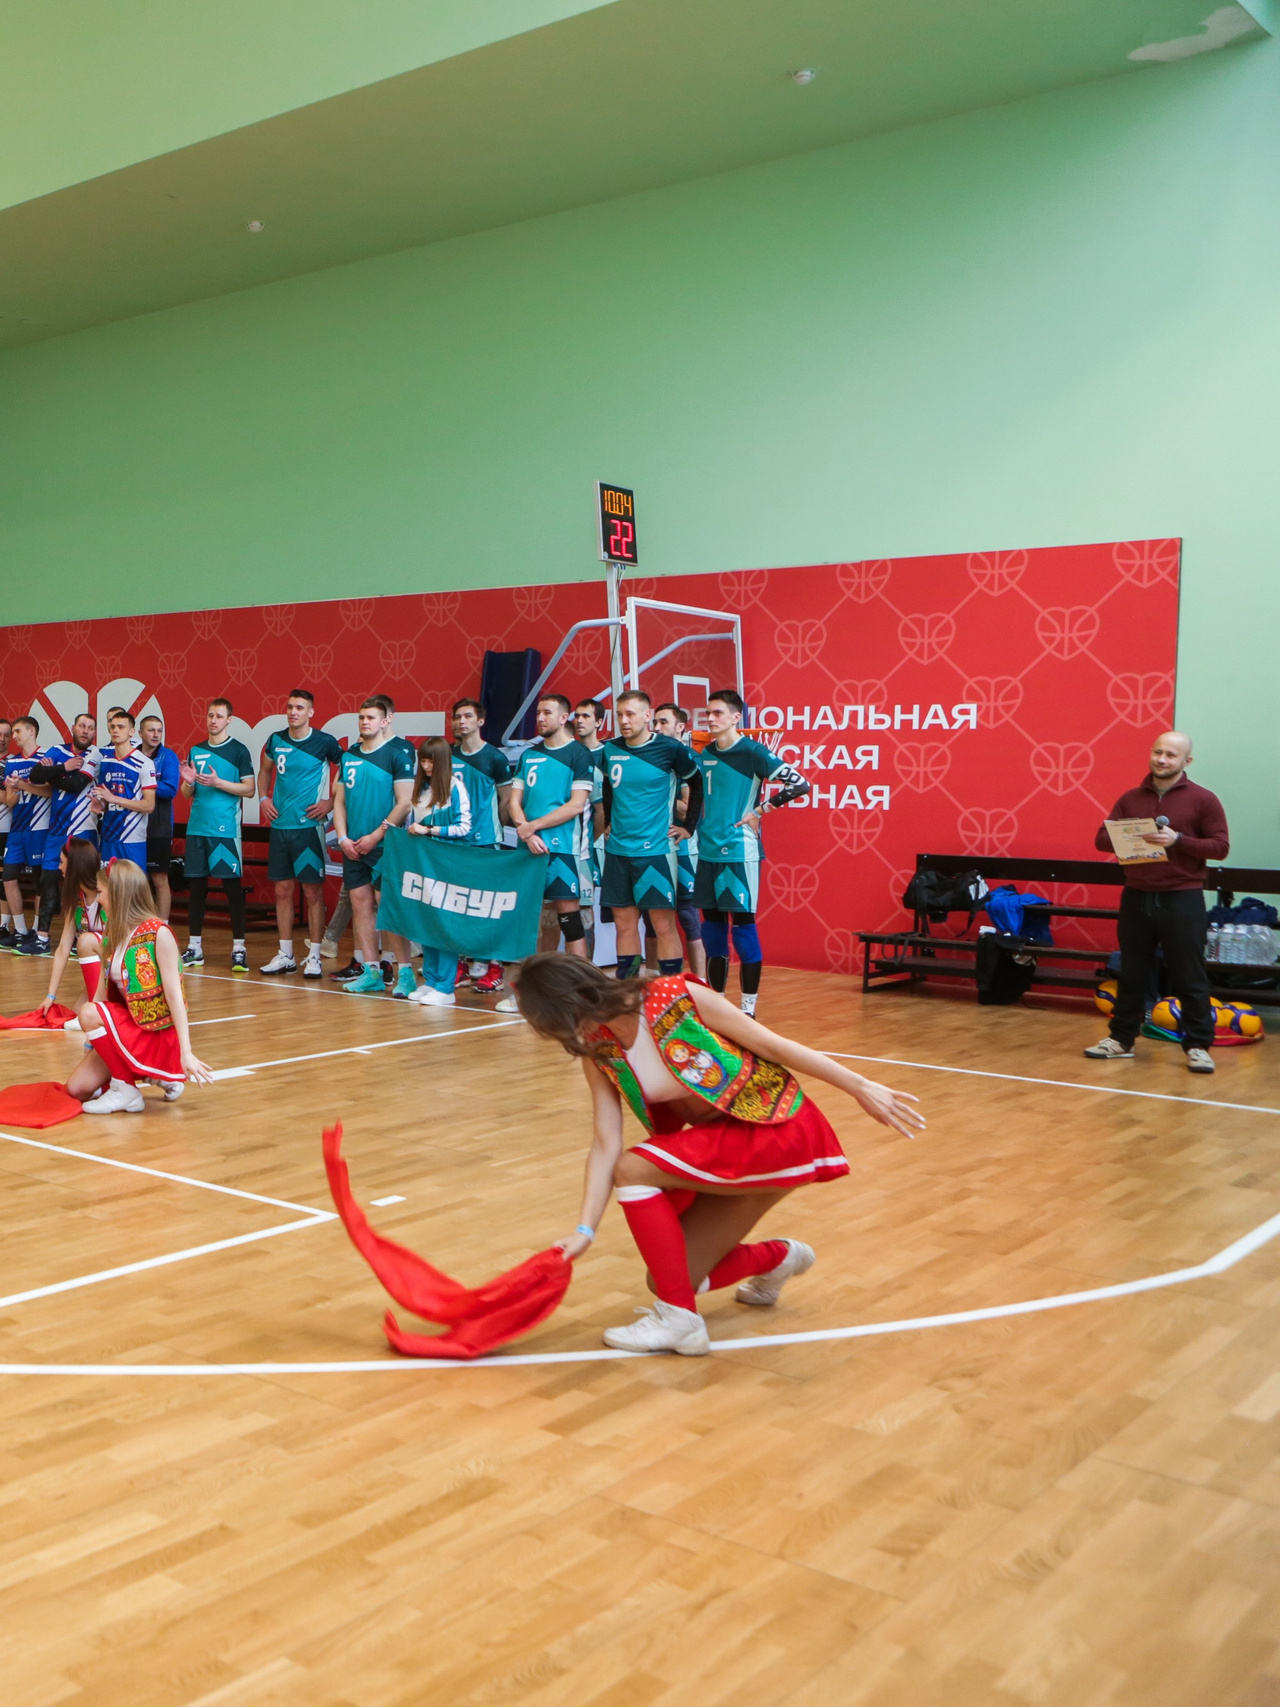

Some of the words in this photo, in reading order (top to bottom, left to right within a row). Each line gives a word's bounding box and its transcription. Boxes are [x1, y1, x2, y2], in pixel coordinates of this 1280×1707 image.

[610, 519, 633, 558] 22
[197, 760, 206, 774] 7
[277, 754, 286, 774] 8
[346, 768, 356, 789] 3
[526, 765, 538, 788] 6
[610, 764, 623, 788] 9
[706, 770, 712, 795] 1
[232, 863, 238, 873] 7
[592, 870, 598, 881] 2
[402, 871, 518, 920] СИБУР
[570, 882, 576, 893] 6
[582, 888, 592, 898] 12
[688, 882, 694, 892] 2
[738, 892, 744, 904] 1
